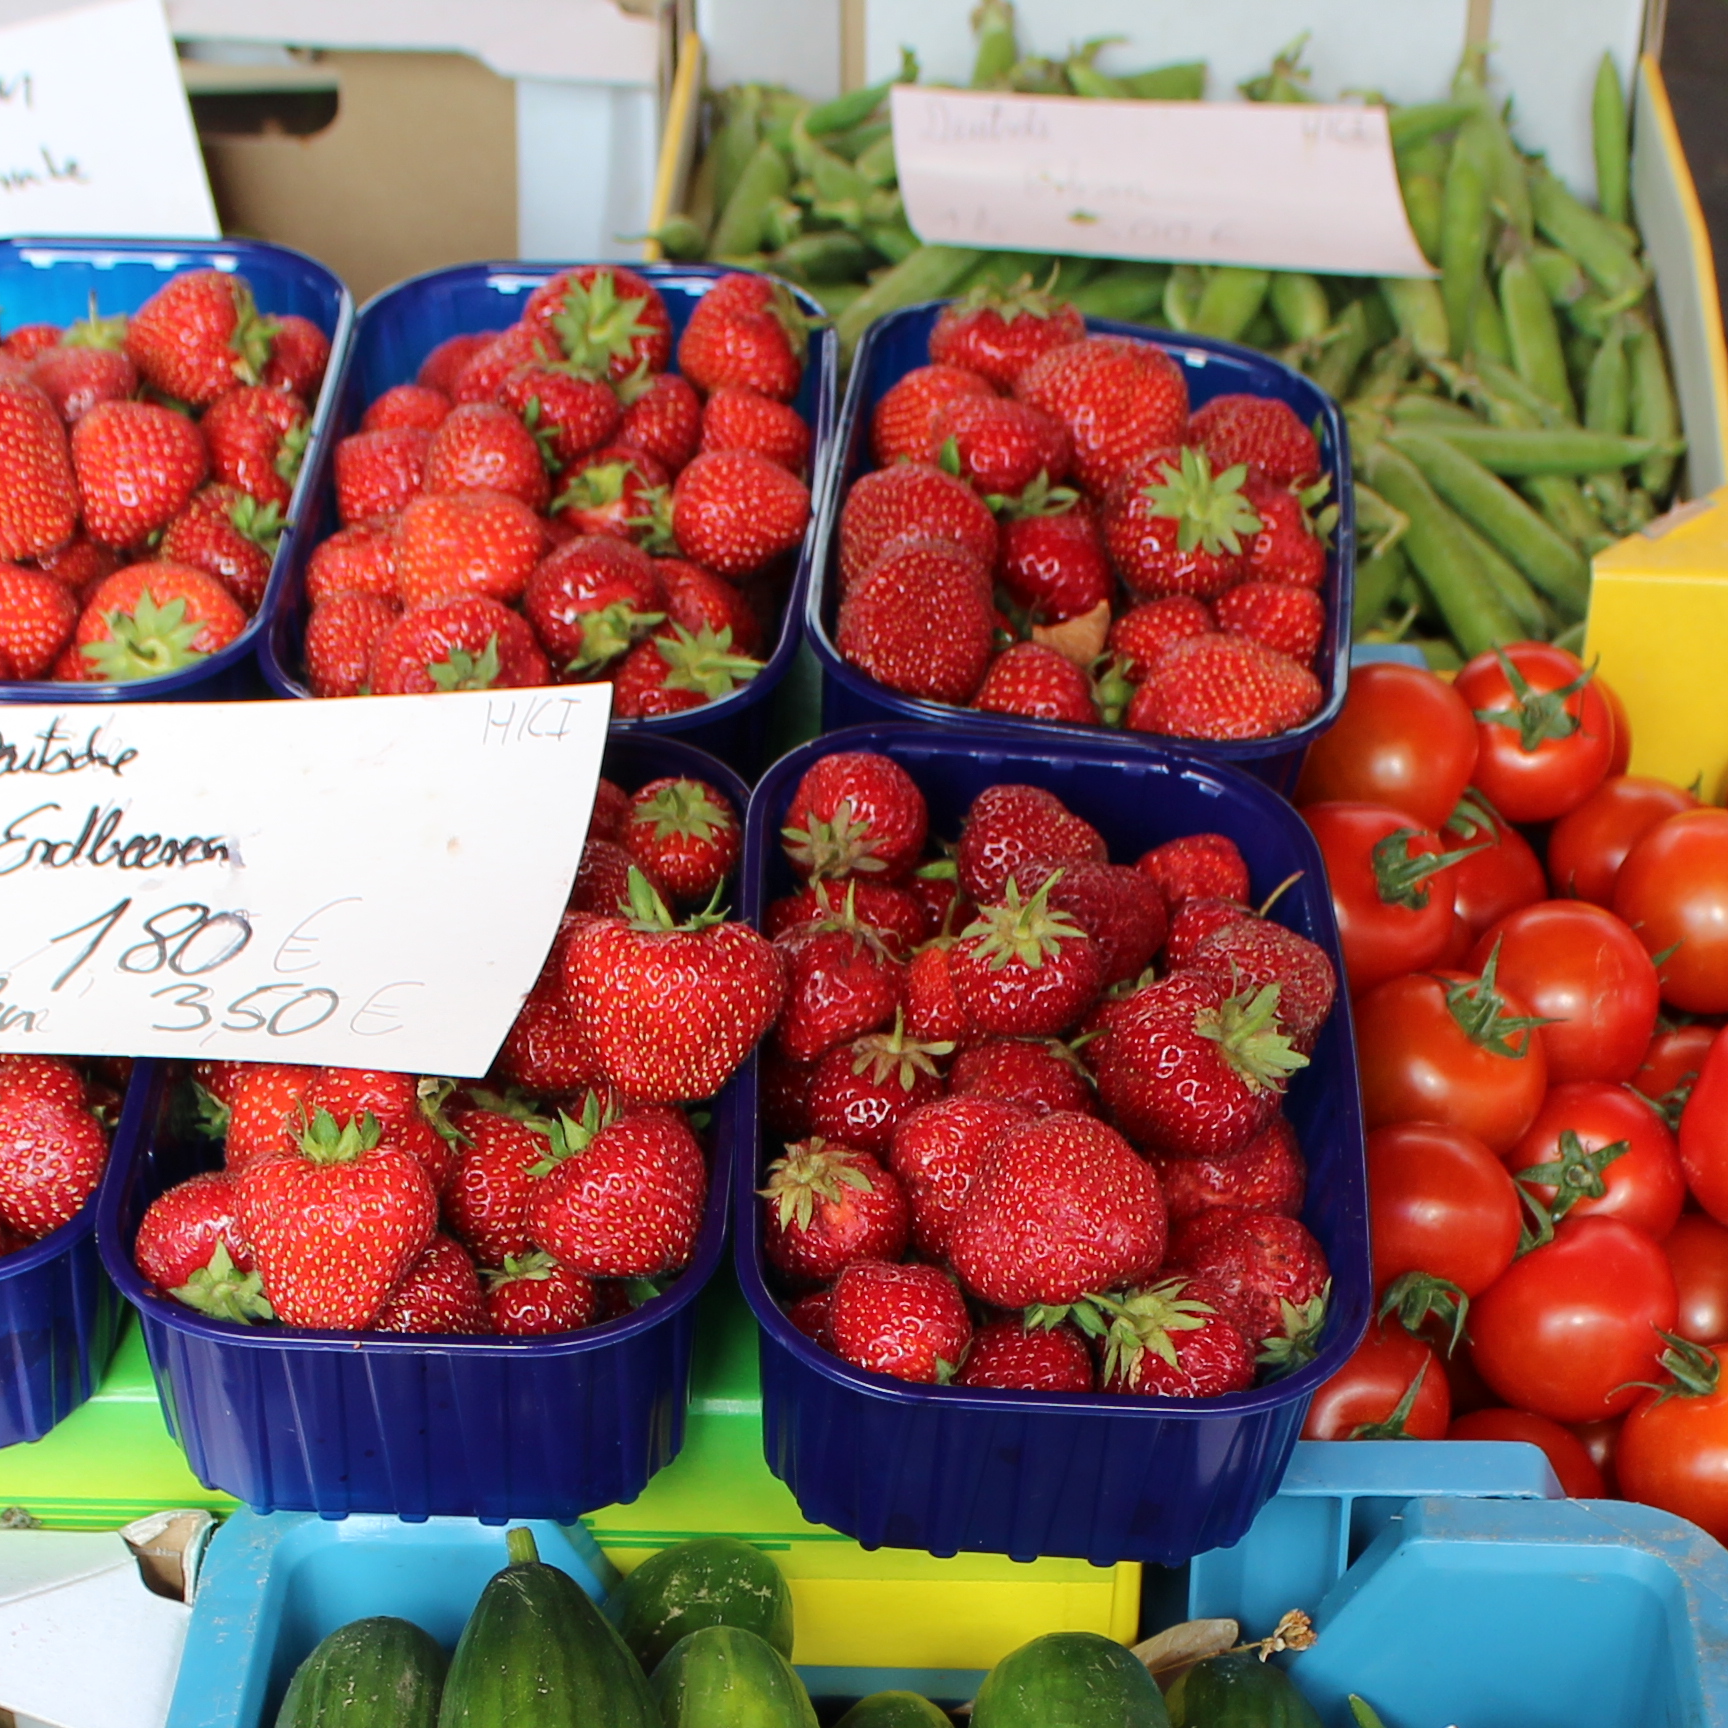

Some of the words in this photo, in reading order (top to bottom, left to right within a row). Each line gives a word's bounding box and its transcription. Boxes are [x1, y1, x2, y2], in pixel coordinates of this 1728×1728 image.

[274, 896, 363, 973] €
[150, 982, 340, 1047] 3,50
[349, 980, 426, 1036] €
